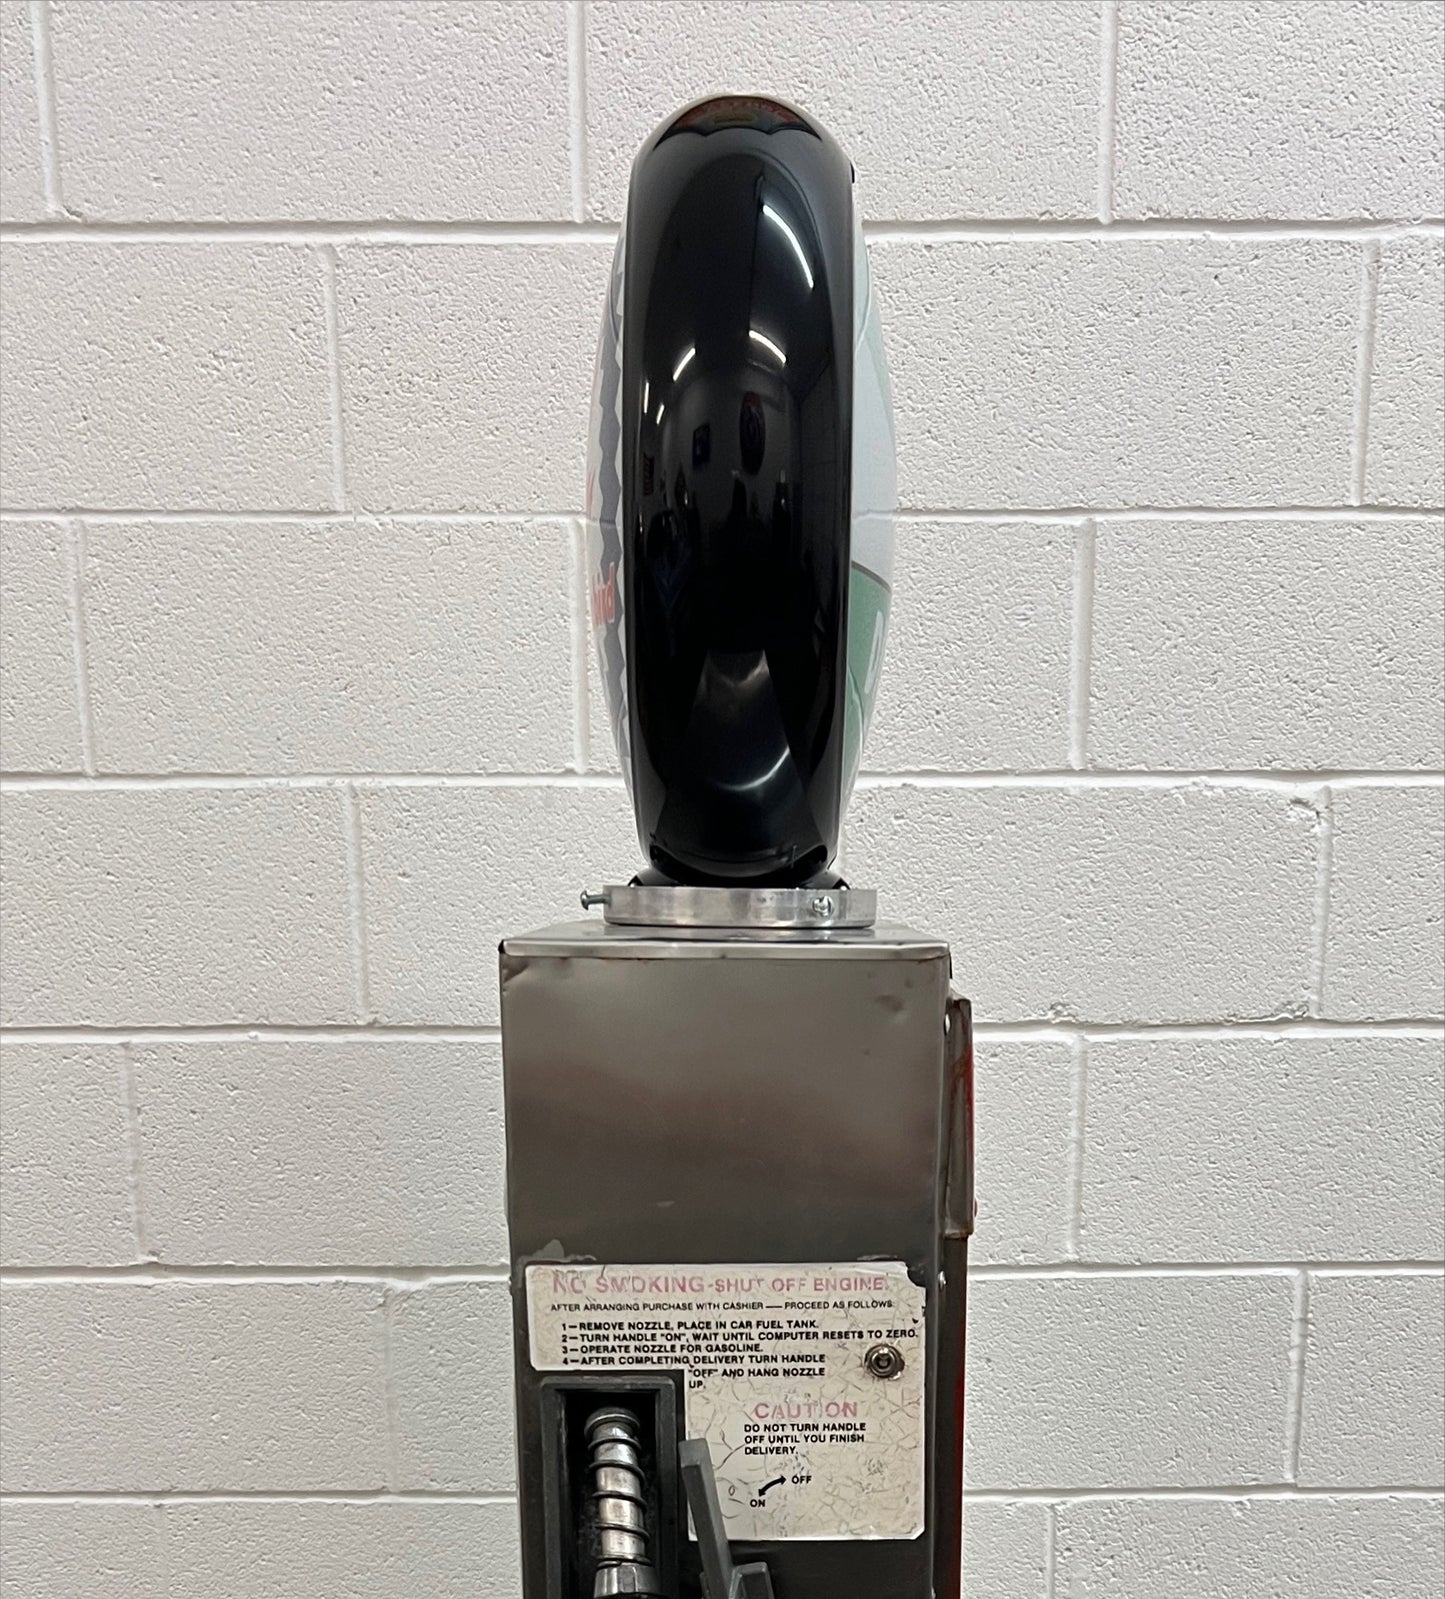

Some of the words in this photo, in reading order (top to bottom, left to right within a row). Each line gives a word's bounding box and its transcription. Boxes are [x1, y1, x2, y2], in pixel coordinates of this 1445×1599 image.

[771, 1277, 807, 1292] OFF
[551, 1303, 580, 1312] AFTER
[583, 1302, 640, 1312] ARRANGING
[642, 1302, 693, 1311] PURCHASE
[696, 1302, 720, 1311] WITH
[722, 1301, 764, 1310] CASHIER
[784, 1301, 830, 1310] PROCEED
[832, 1300, 845, 1310] AS
[628, 1321, 674, 1331] NOZZLE,
[677, 1320, 712, 1330] PLACE
[716, 1320, 727, 1330] IN
[730, 1320, 753, 1330] CAR
[756, 1320, 784, 1330] FUEL
[613, 1332, 657, 1342] HANDLE
[692, 1332, 720, 1341] WAIT
[722, 1331, 755, 1341] UNTIL
[757, 1330, 820, 1341] COMPUTER
[822, 1329, 864, 1340] RESETS
[868, 1329, 883, 1339] TO
[634, 1344, 677, 1354] NOZZLE
[680, 1343, 702, 1353] FOR
[705, 1343, 764, 1353] GASOLINE.
[618, 1355, 690, 1366] COMPLETING
[693, 1354, 745, 1365] DELIVERY
[748, 1354, 778, 1364] TURN
[781, 1353, 826, 1364] HANDLE
[721, 1367, 745, 1378] AND
[747, 1367, 780, 1378] HANG
[782, 1366, 826, 1377] NOZZLE
[754, 1401, 858, 1420] CAUTON
[743, 1423, 761, 1433] DO
[763, 1423, 787, 1433] NOT
[790, 1423, 819, 1432] TURN
[822, 1422, 867, 1432] HANDLE
[744, 1434, 766, 1445] OFF
[768, 1434, 801, 1444] UNTIL
[803, 1433, 827, 1443] YOU
[829, 1433, 865, 1443] FINISH
[744, 1445, 799, 1456] DELIVERY.
[791, 1474, 812, 1485] OFF
[750, 1498, 766, 1508] ON
